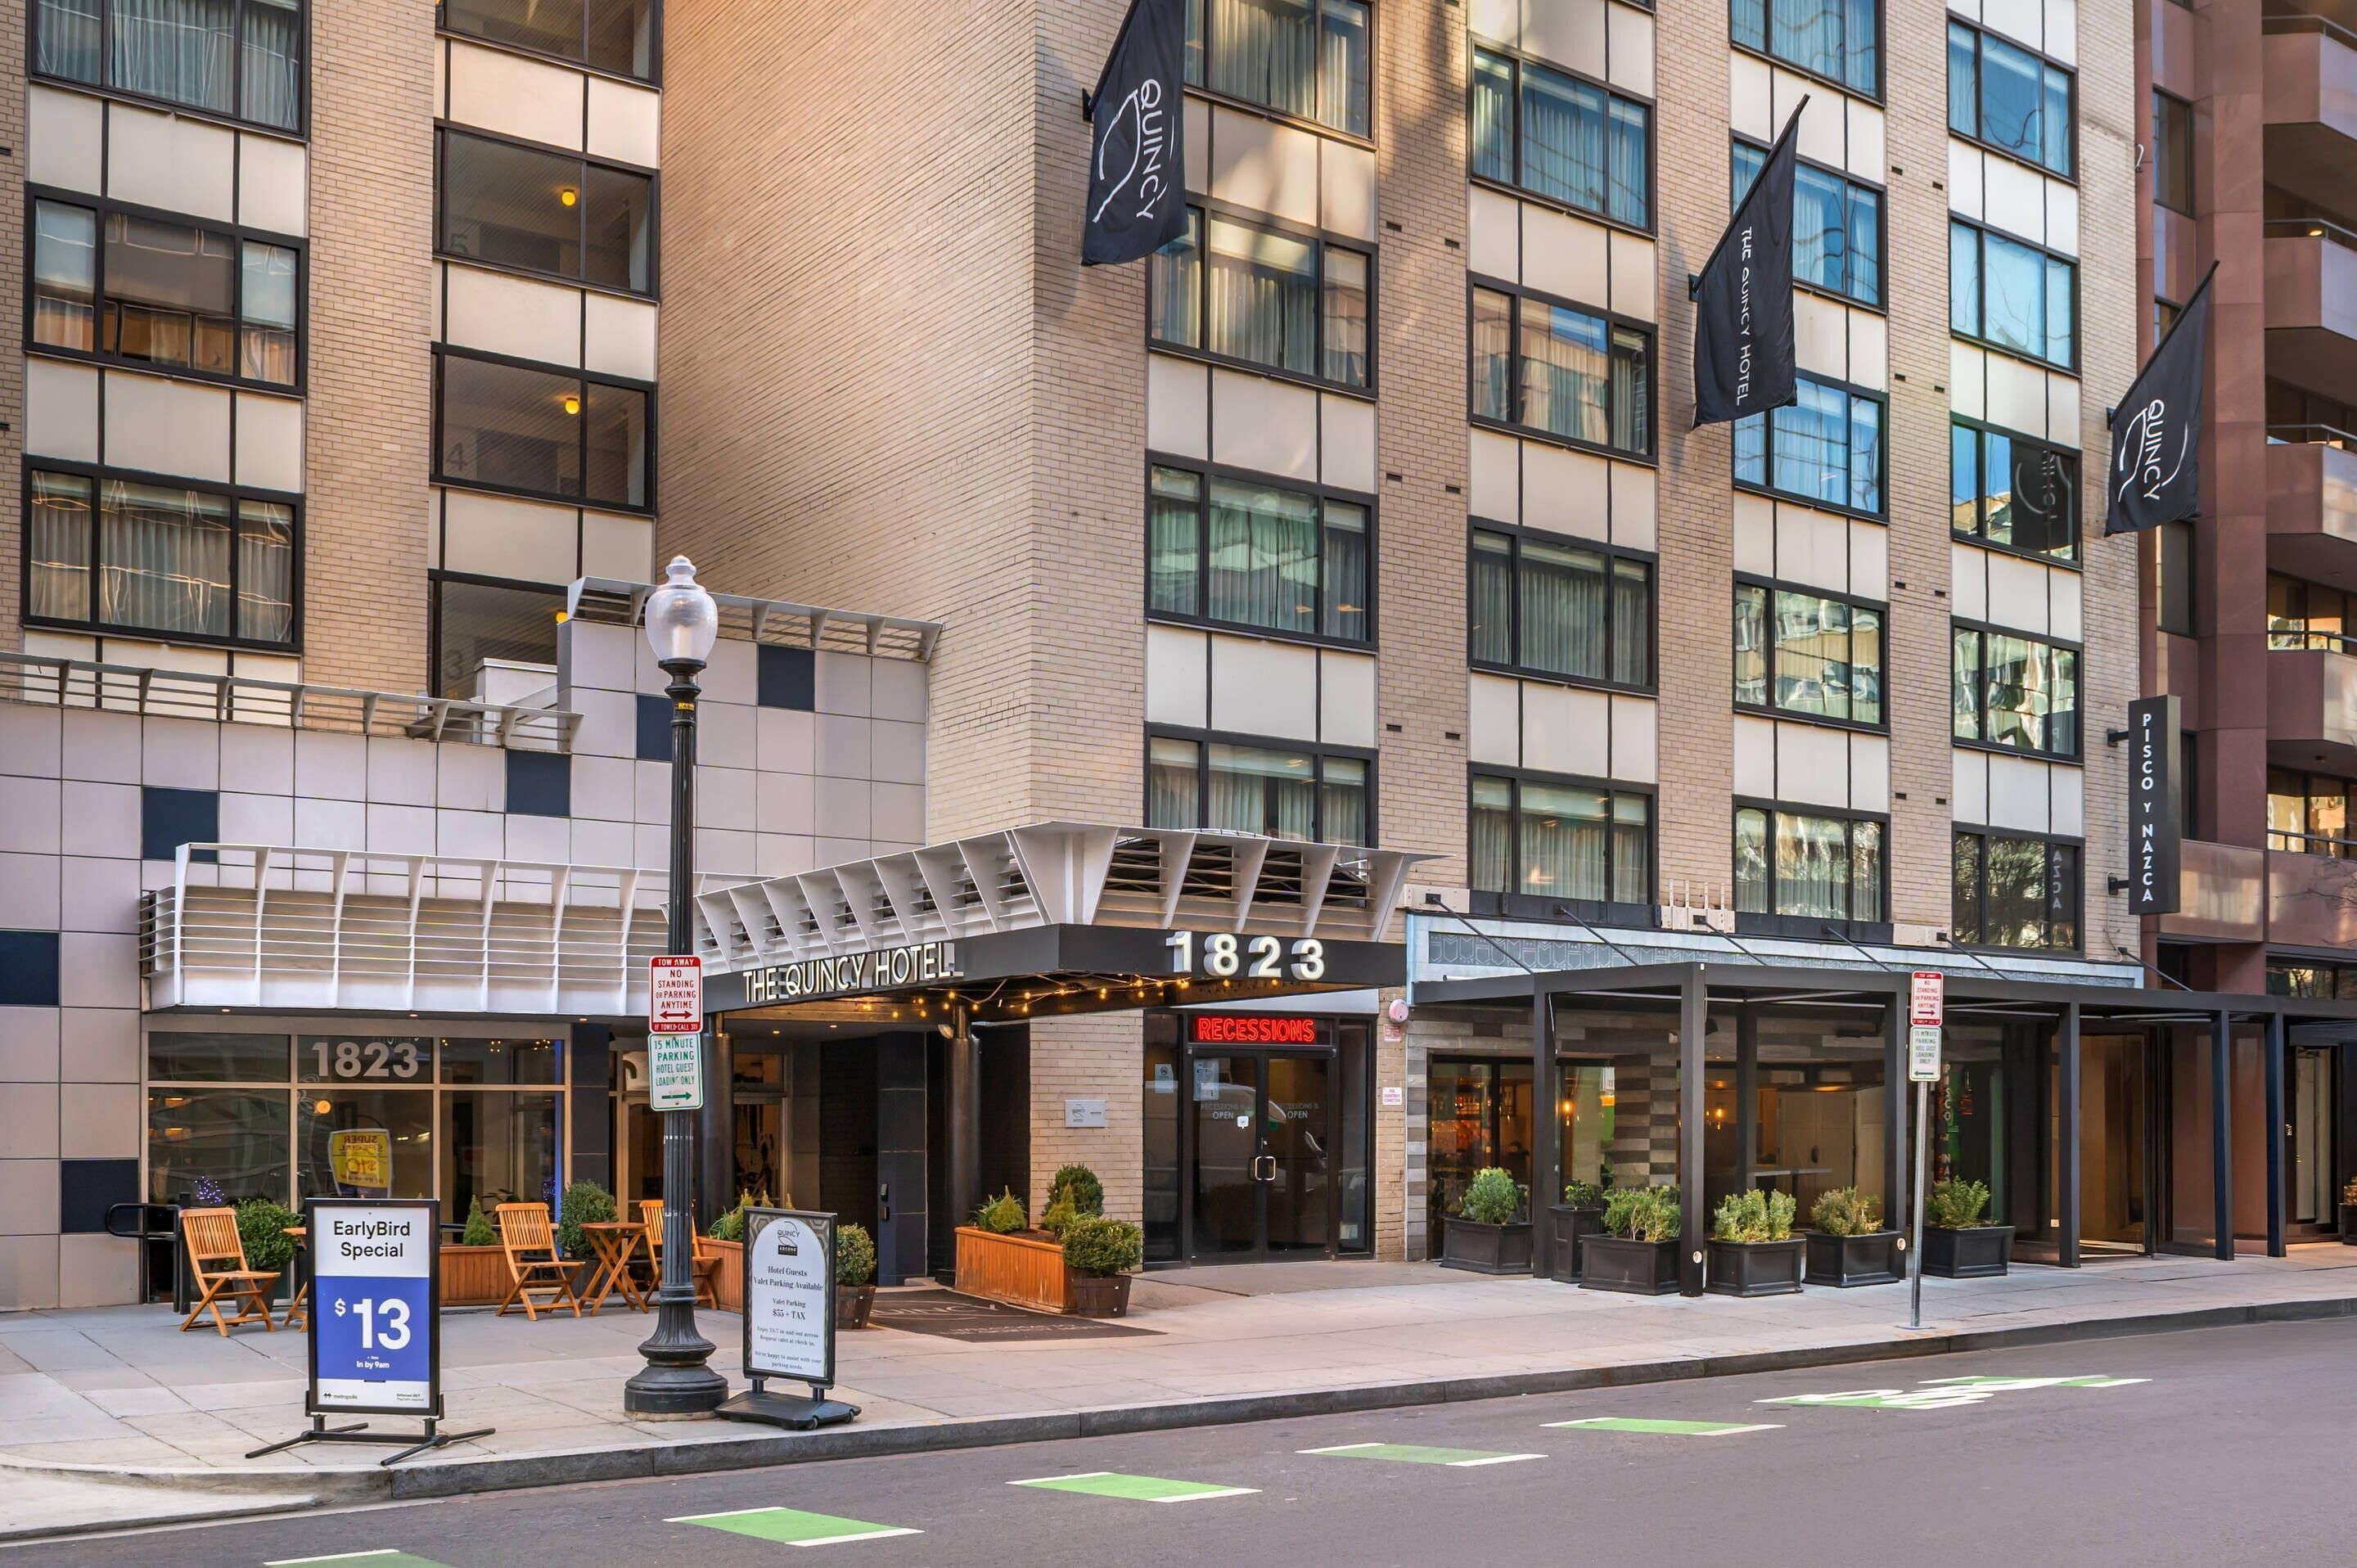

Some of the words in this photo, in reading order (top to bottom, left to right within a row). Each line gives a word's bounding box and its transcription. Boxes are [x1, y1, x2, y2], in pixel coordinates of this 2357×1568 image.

[1136, 79, 1162, 219] QUINCY
[1741, 227, 1752, 261] THE
[1741, 267, 1750, 336] QUINCY
[1737, 345, 1751, 406] HOTEL
[2143, 399, 2165, 500] QUINCY
[446, 443, 467, 471] 4
[2141, 714, 2154, 791] PISCO
[2143, 802, 2152, 813] Y
[2142, 824, 2153, 901] NAZCA
[1165, 930, 1325, 980] 1823
[670, 970, 682, 978] NO
[742, 967, 777, 1002] THE
[786, 953, 866, 995] QUINCY
[876, 942, 953, 986] HOTEL
[664, 990, 696, 998] PARKING
[661, 1001, 692, 1009] ANYTIME
[1198, 1017, 1314, 1042] RECESSIONS
[655, 1040, 662, 1049] 15
[665, 1039, 694, 1048] MINUTE
[312, 1042, 418, 1078] 1823
[657, 1051, 694, 1061] PARKING
[656, 1064, 674, 1074] HOTEL
[676, 1063, 694, 1072] GUEST
[681, 1075, 695, 1085] ONLY
[1212, 1111, 1234, 1120] OPEN
[1287, 1111, 1308, 1119] OPEN
[334, 1220, 410, 1239] EarlyBird
[777, 1229, 800, 1237] QUINCY
[341, 1241, 403, 1260] Special
[768, 1266, 785, 1274] Hotel
[786, 1268, 808, 1277] Guests
[754, 1277, 768, 1285] Valet
[769, 1278, 794, 1289] Parking
[795, 1282, 823, 1291] Available
[786, 1300, 806, 1308] Parking
[791, 1311, 805, 1320] TAX
[365, 1361, 373, 1369] by
